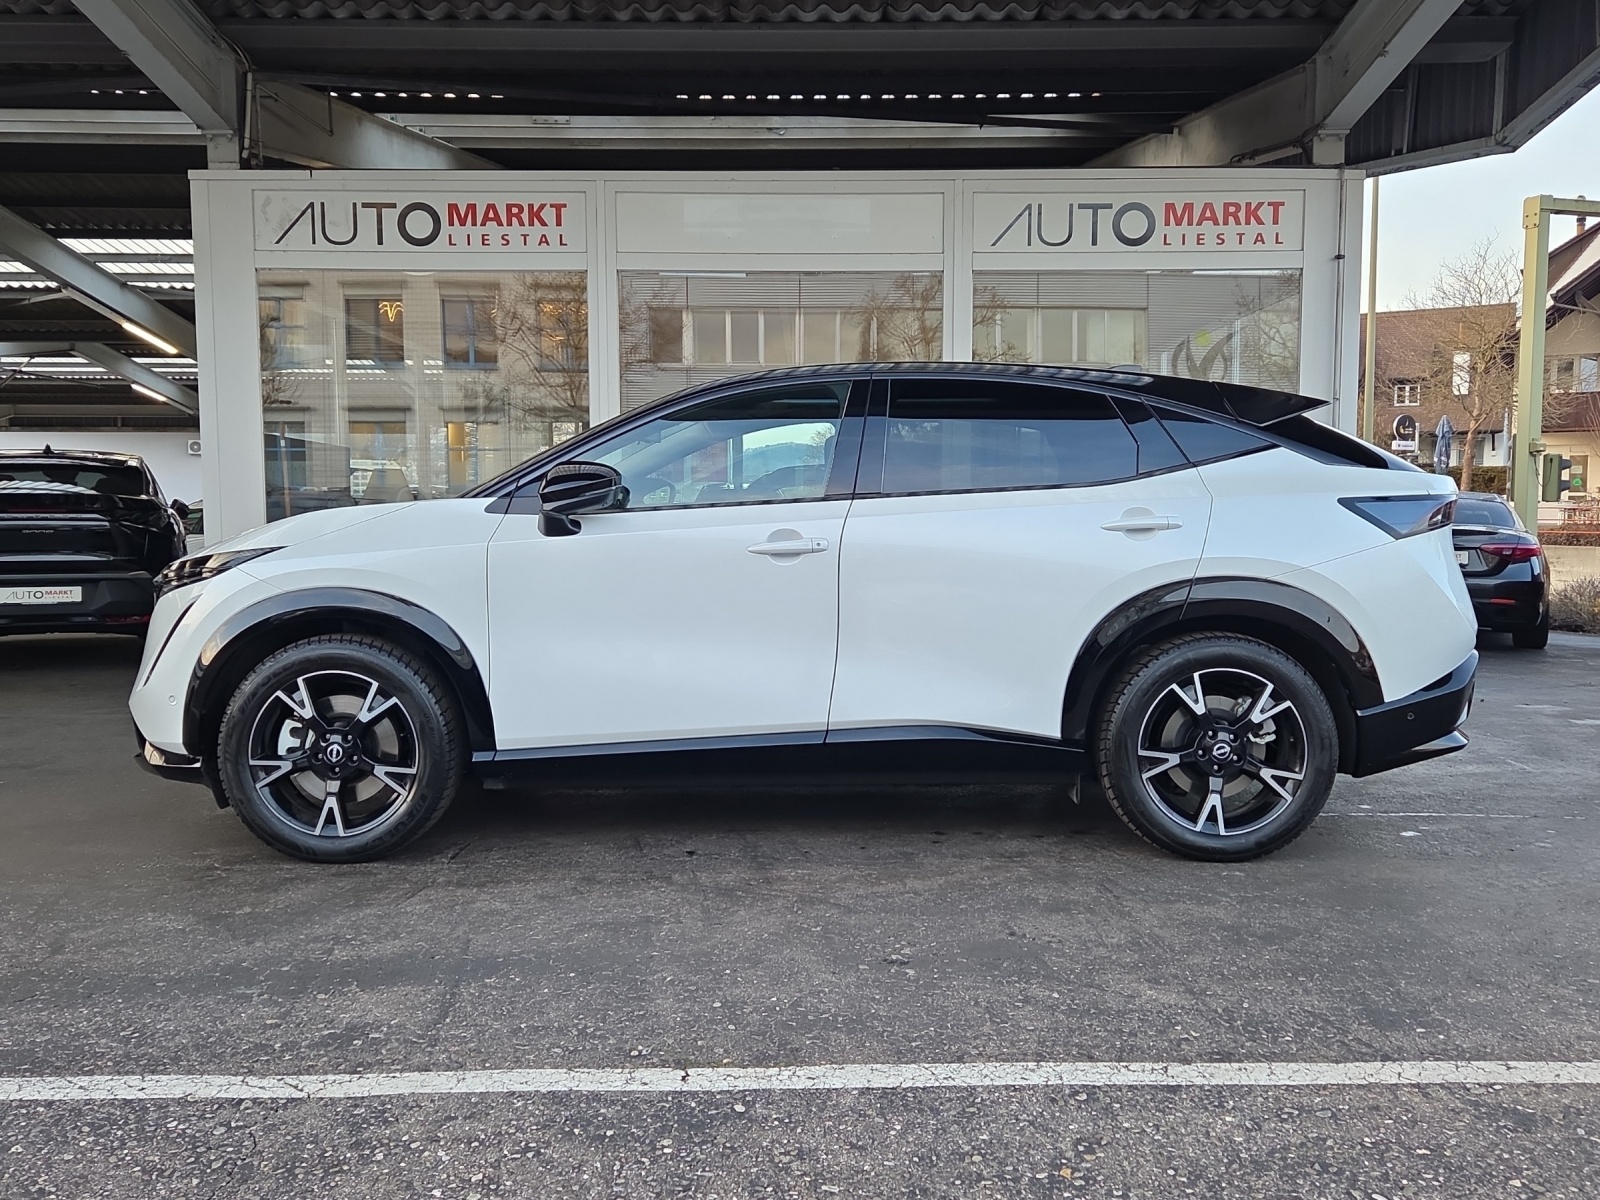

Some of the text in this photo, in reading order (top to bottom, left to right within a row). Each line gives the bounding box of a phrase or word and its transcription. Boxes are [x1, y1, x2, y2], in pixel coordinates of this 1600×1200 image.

[447, 202, 568, 227] MARKT
[1163, 201, 1286, 227] MARKT
[447, 233, 568, 247] LIESTAL
[1163, 232, 1285, 246] LIESTAL
